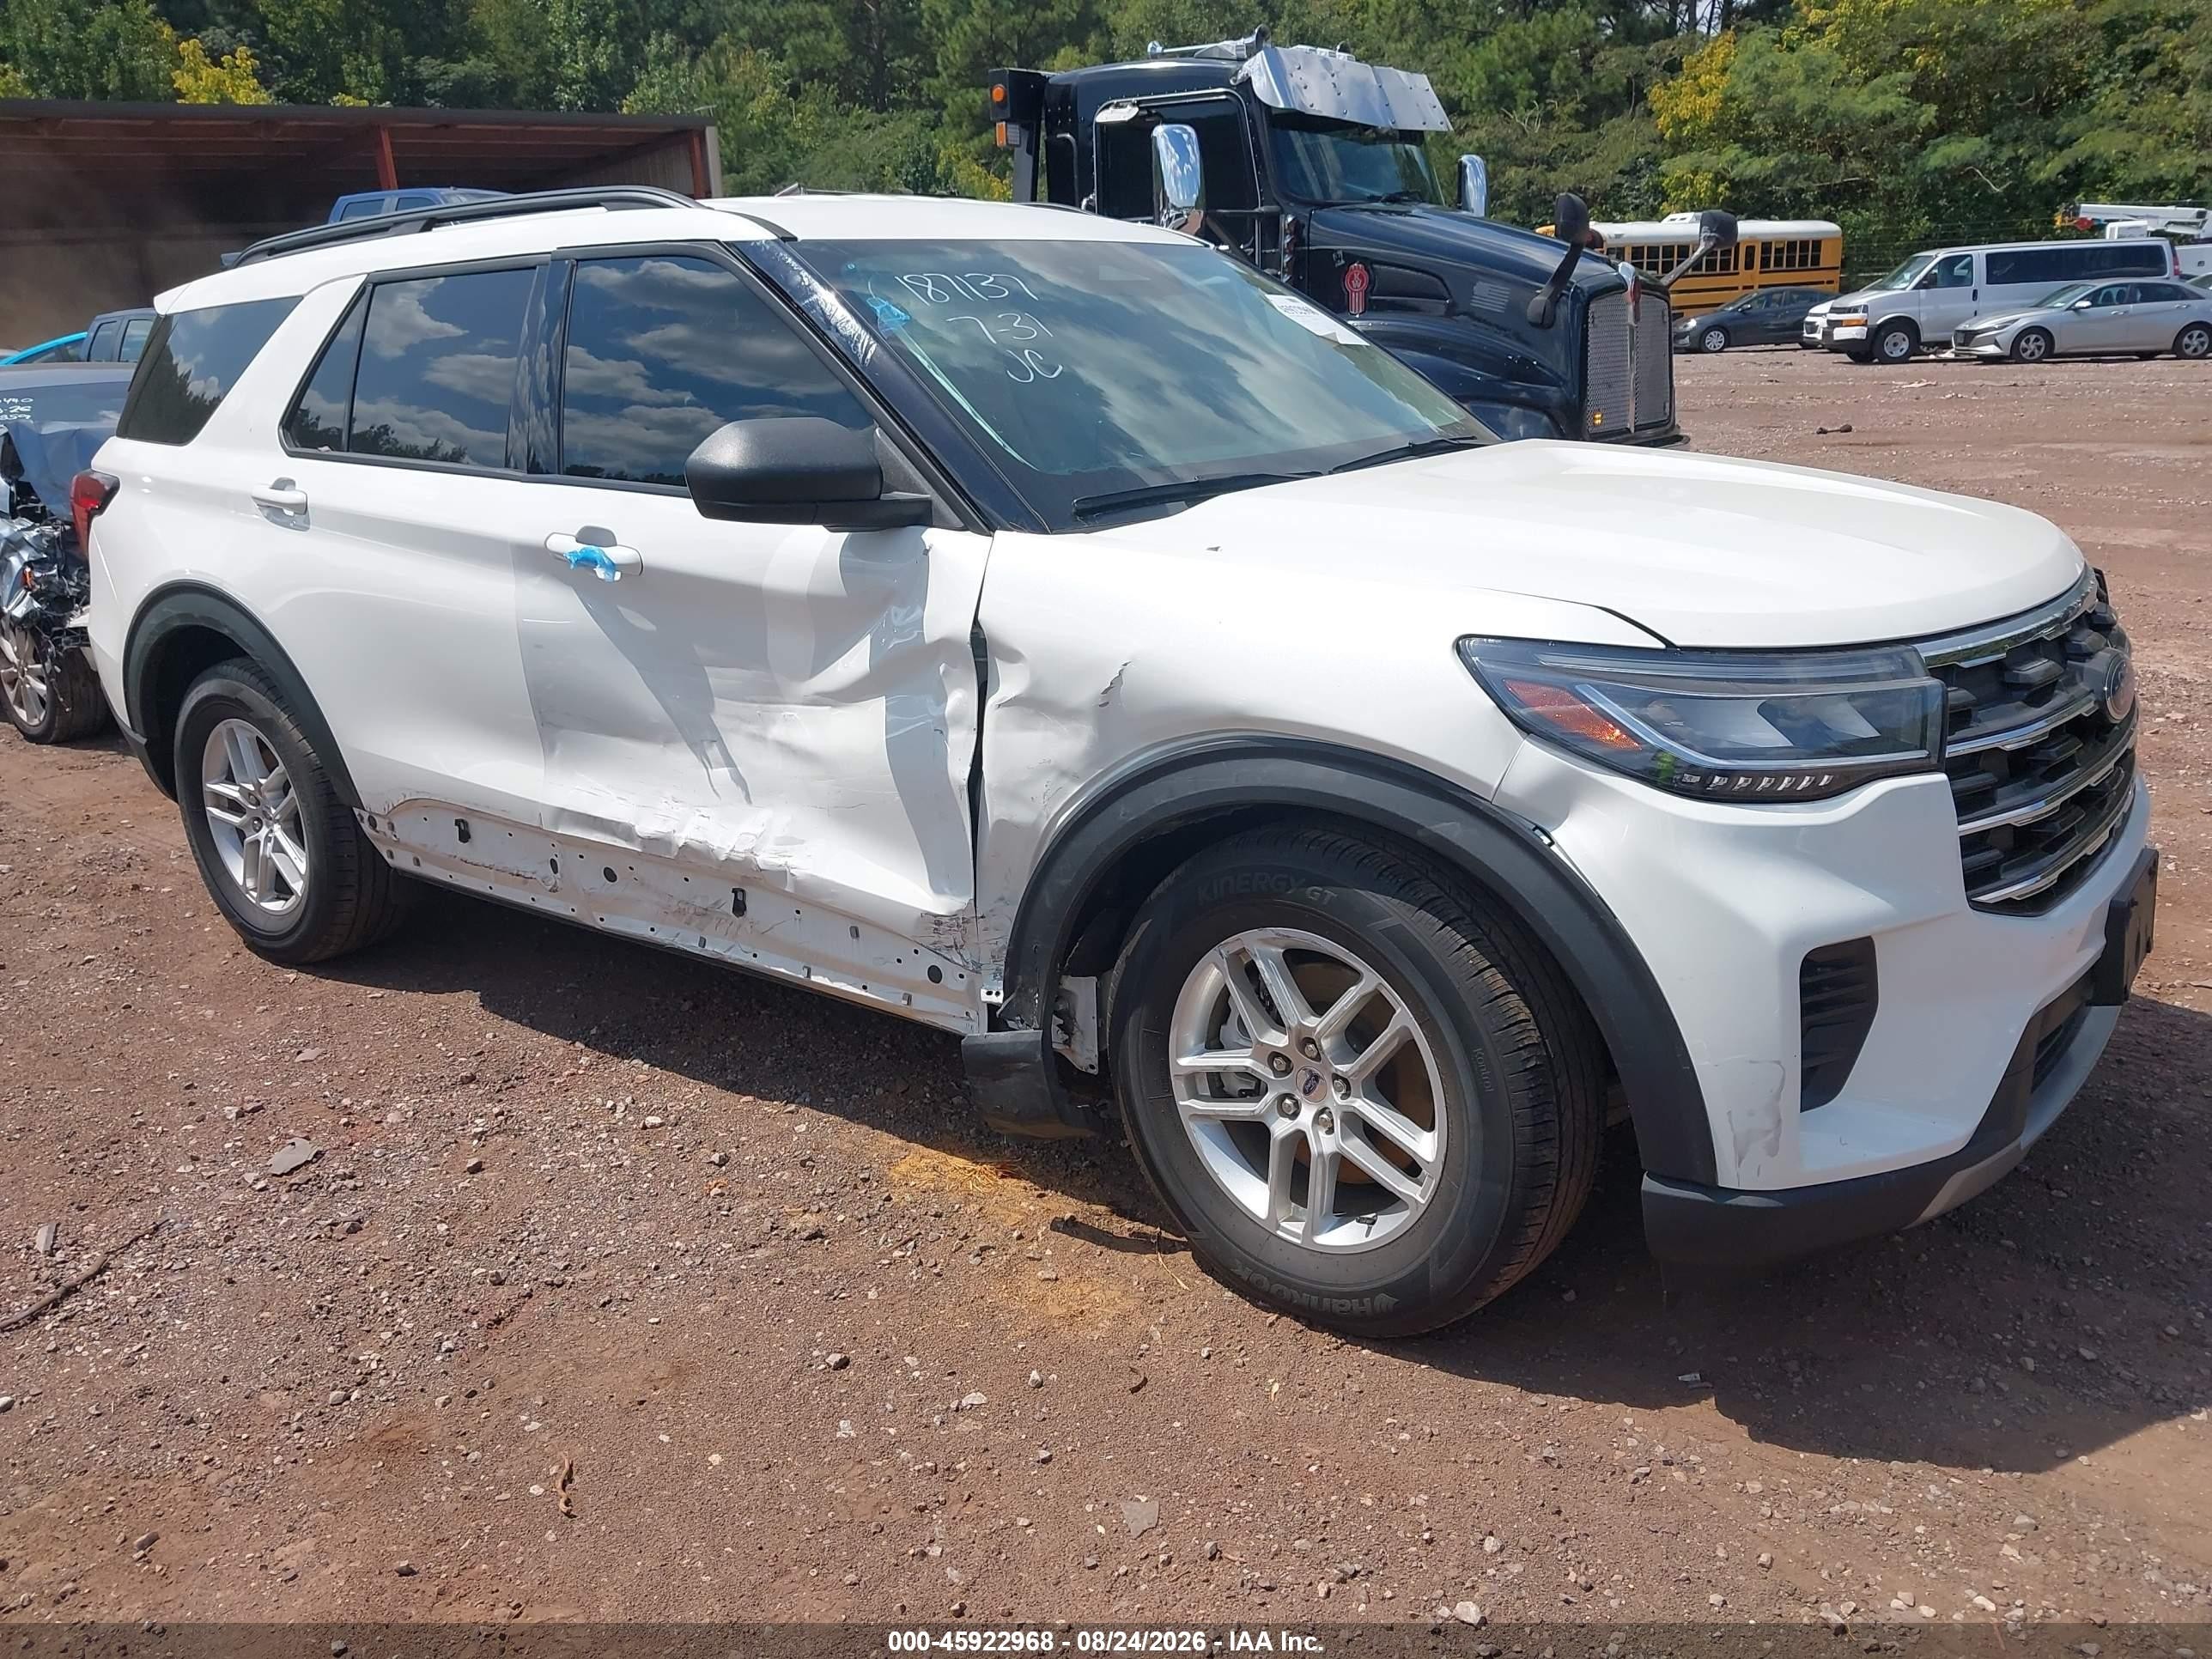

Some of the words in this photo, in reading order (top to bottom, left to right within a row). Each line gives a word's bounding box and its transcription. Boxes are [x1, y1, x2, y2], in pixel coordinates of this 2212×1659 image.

[894, 272, 1040, 307] 187137
[945, 311, 1054, 344] 7-31
[1006, 349, 1064, 383] JC
[1304, 885, 1339, 906] GT
